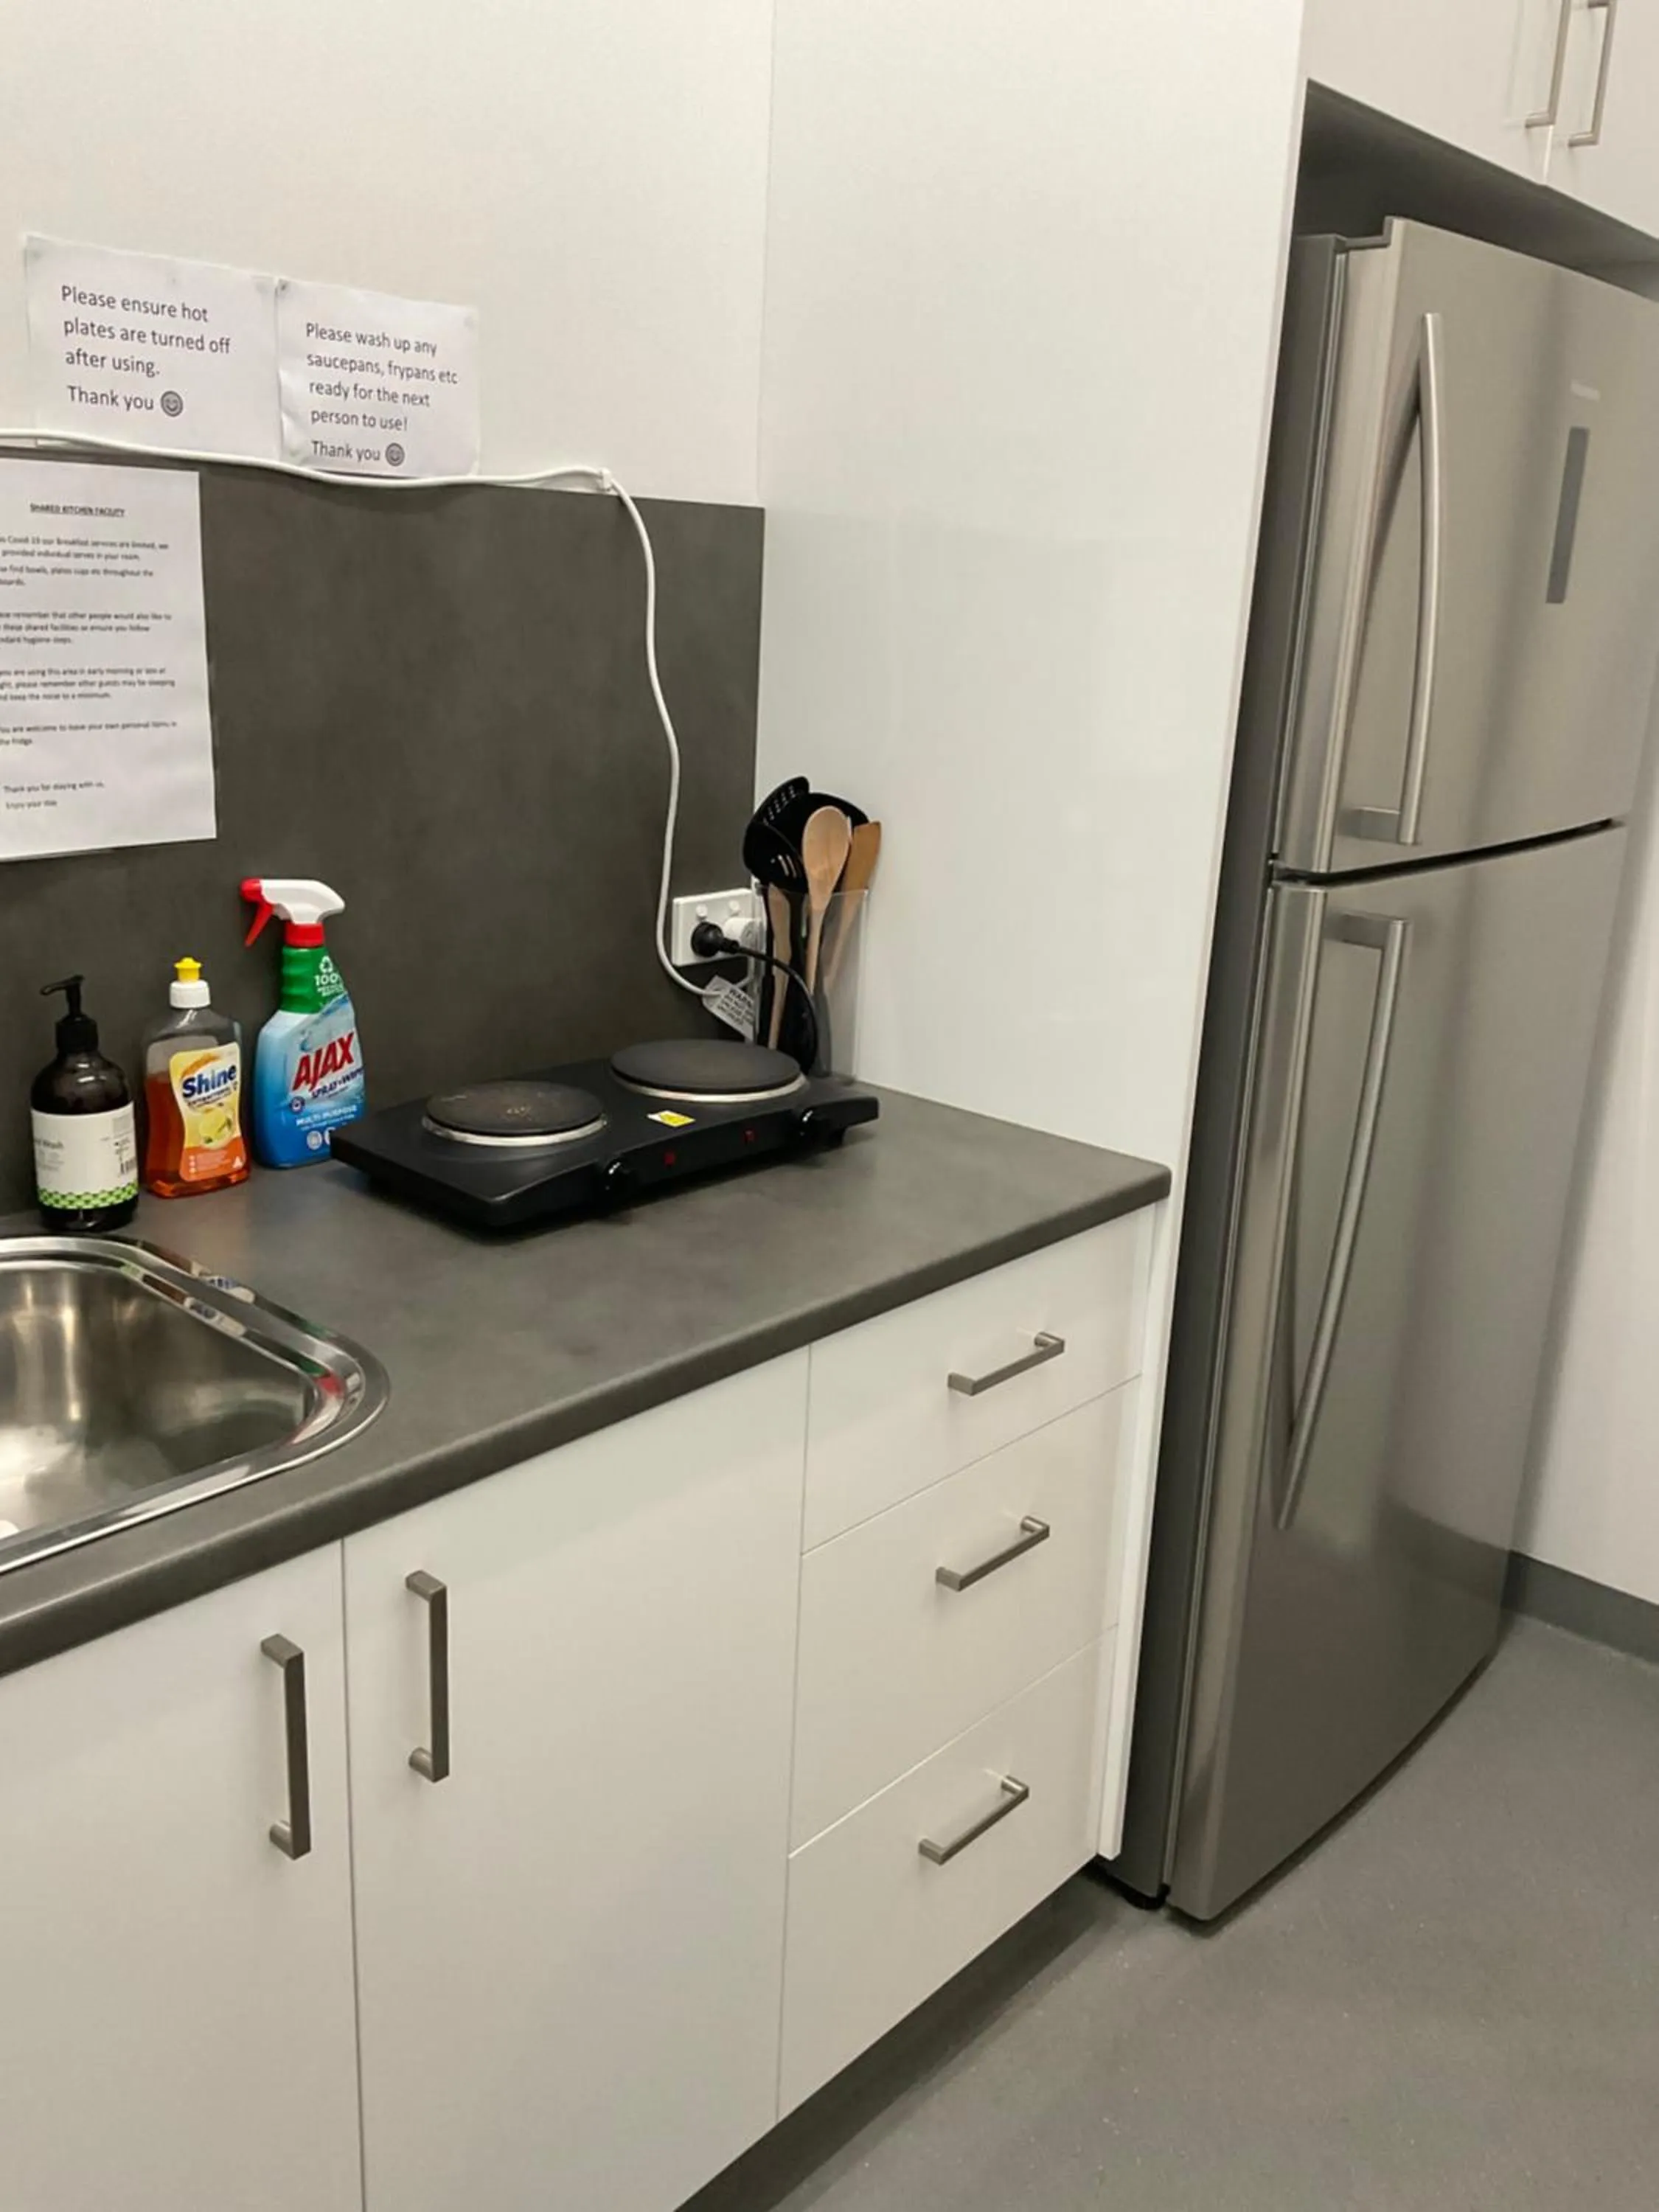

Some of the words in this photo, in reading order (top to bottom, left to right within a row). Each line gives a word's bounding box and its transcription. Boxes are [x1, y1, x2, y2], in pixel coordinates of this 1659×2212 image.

[61, 285, 116, 310] Please
[121, 296, 177, 319] ensure
[181, 301, 209, 323] hot
[63, 316, 116, 340] plates
[119, 327, 147, 344] are
[151, 329, 205, 352] turned
[209, 336, 232, 354] off
[306, 322, 352, 344] Please
[355, 331, 391, 349] wash
[393, 336, 411, 353] up
[414, 339, 437, 358] any
[65, 347, 108, 369] after
[111, 355, 160, 378] using.
[307, 352, 385, 378] saucepans,
[388, 360, 436, 382] frypans
[438, 369, 460, 385] etc
[67, 384, 119, 407] Thank
[123, 394, 155, 411] you
[309, 380, 350, 401] ready
[352, 383, 373, 400] for
[376, 388, 399, 404] the
[402, 392, 430, 408] next
[310, 409, 359, 425] person
[362, 413, 377, 428] to
[380, 416, 408, 432] use!
[310, 439, 353, 459] Thank
[355, 445, 381, 463] you
[30, 503, 61, 515] SHARED
[62, 505, 94, 516] KITCHEN
[13, 611, 49, 619] remember
[68, 611, 87, 619] other
[88, 613, 112, 622] people
[39, 680, 76, 688] remember
[27, 725, 58, 733] welcome
[292, 1032, 355, 1092] AJAX
[181, 1064, 237, 1099] Shine
